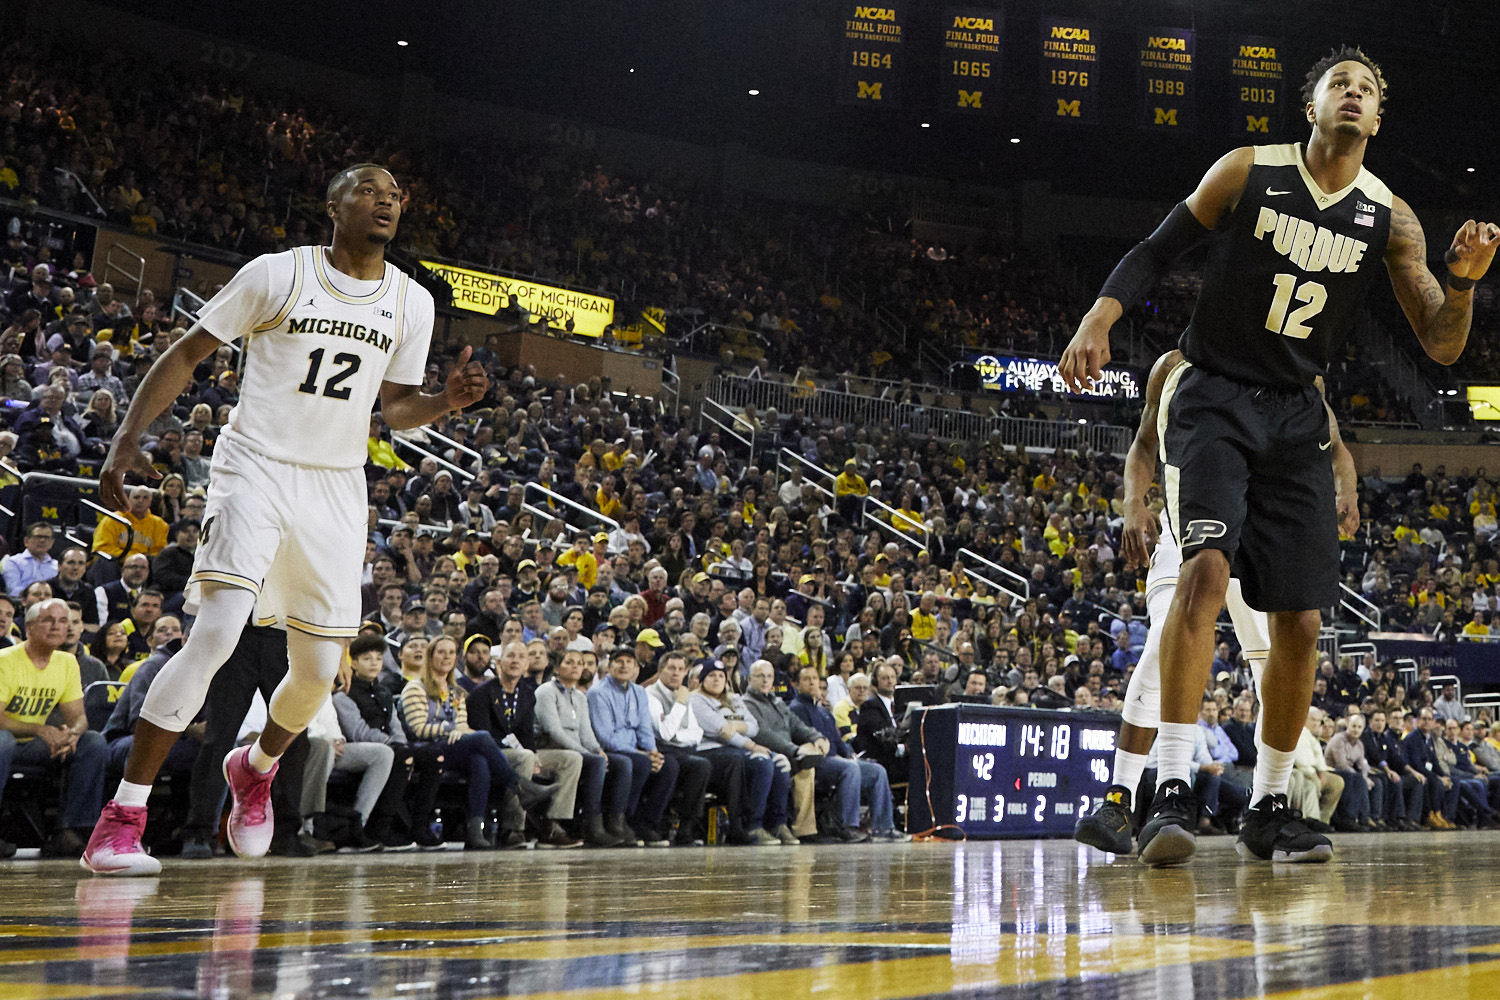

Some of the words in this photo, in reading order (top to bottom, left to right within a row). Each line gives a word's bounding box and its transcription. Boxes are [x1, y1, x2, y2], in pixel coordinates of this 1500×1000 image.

[854, 6, 896, 22] NCAA
[846, 20, 874, 34] FINAL
[877, 23, 902, 35] FOUR
[953, 16, 994, 31] NCAA
[945, 30, 973, 43] FINAL
[975, 33, 1000, 45] FOUR
[1051, 26, 1090, 41] NCAA
[1043, 40, 1071, 53] FINAL
[1072, 43, 1096, 54] FOUR
[1148, 36, 1186, 51] NCAA
[1239, 45, 1277, 60] NCAA
[852, 51, 892, 69] 1964
[1141, 51, 1168, 62] FINAL
[1169, 52, 1192, 64] FOUR
[1232, 58, 1259, 71] FINAL
[1260, 60, 1283, 72] FOUR
[952, 60, 991, 78] 1965
[1050, 69, 1089, 87] 1976
[857, 80, 883, 100] M
[1148, 79, 1185, 96] 1989
[1240, 87, 1276, 104] 2013
[957, 89, 982, 109] M
[1056, 99, 1081, 117] M
[1154, 107, 1178, 126] M
[1246, 115, 1269, 133] M
[1253, 206, 1369, 273] PURDUE
[452, 287, 507, 308] CREDIT
[529, 301, 575, 321] UNION
[517, 286, 536, 299] OF
[540, 290, 611, 314] MICHIGAN
[1264, 273, 1329, 340] 12
[287, 318, 393, 354] MICHIGAN
[298, 347, 362, 401] 12
[1006, 374, 1070, 393] FOREER
[1182, 518, 1227, 546] P
[5, 695, 54, 716] BLUE
[958, 722, 1007, 747] MICHIGAN
[1019, 724, 1071, 760] 14:18
[1082, 728, 1116, 751] PURDUE
[972, 752, 995, 780] 42
[1090, 758, 1110, 783] 46
[1027, 772, 1057, 788] PERIOD
[956, 794, 968, 823] 3
[992, 794, 1005, 823] 3
[1007, 802, 1027, 815] FOULS
[1034, 794, 1046, 822] 2
[1055, 802, 1074, 815] FOULS
